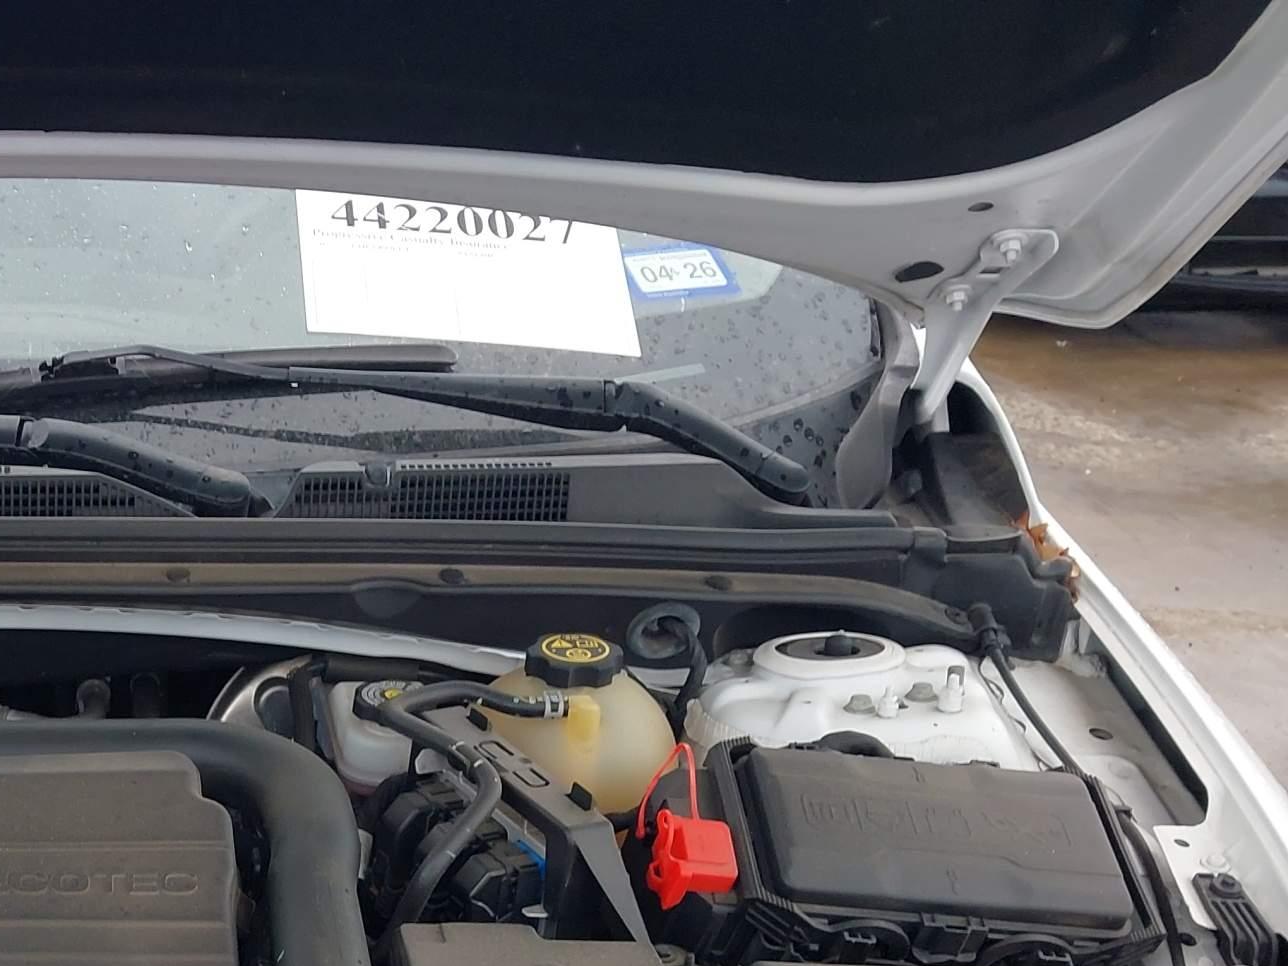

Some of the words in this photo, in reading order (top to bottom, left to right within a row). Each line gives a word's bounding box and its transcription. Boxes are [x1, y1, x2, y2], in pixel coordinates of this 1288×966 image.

[330, 199, 577, 245] 44220027
[640, 265, 673, 283] 04
[683, 261, 717, 279] 26
